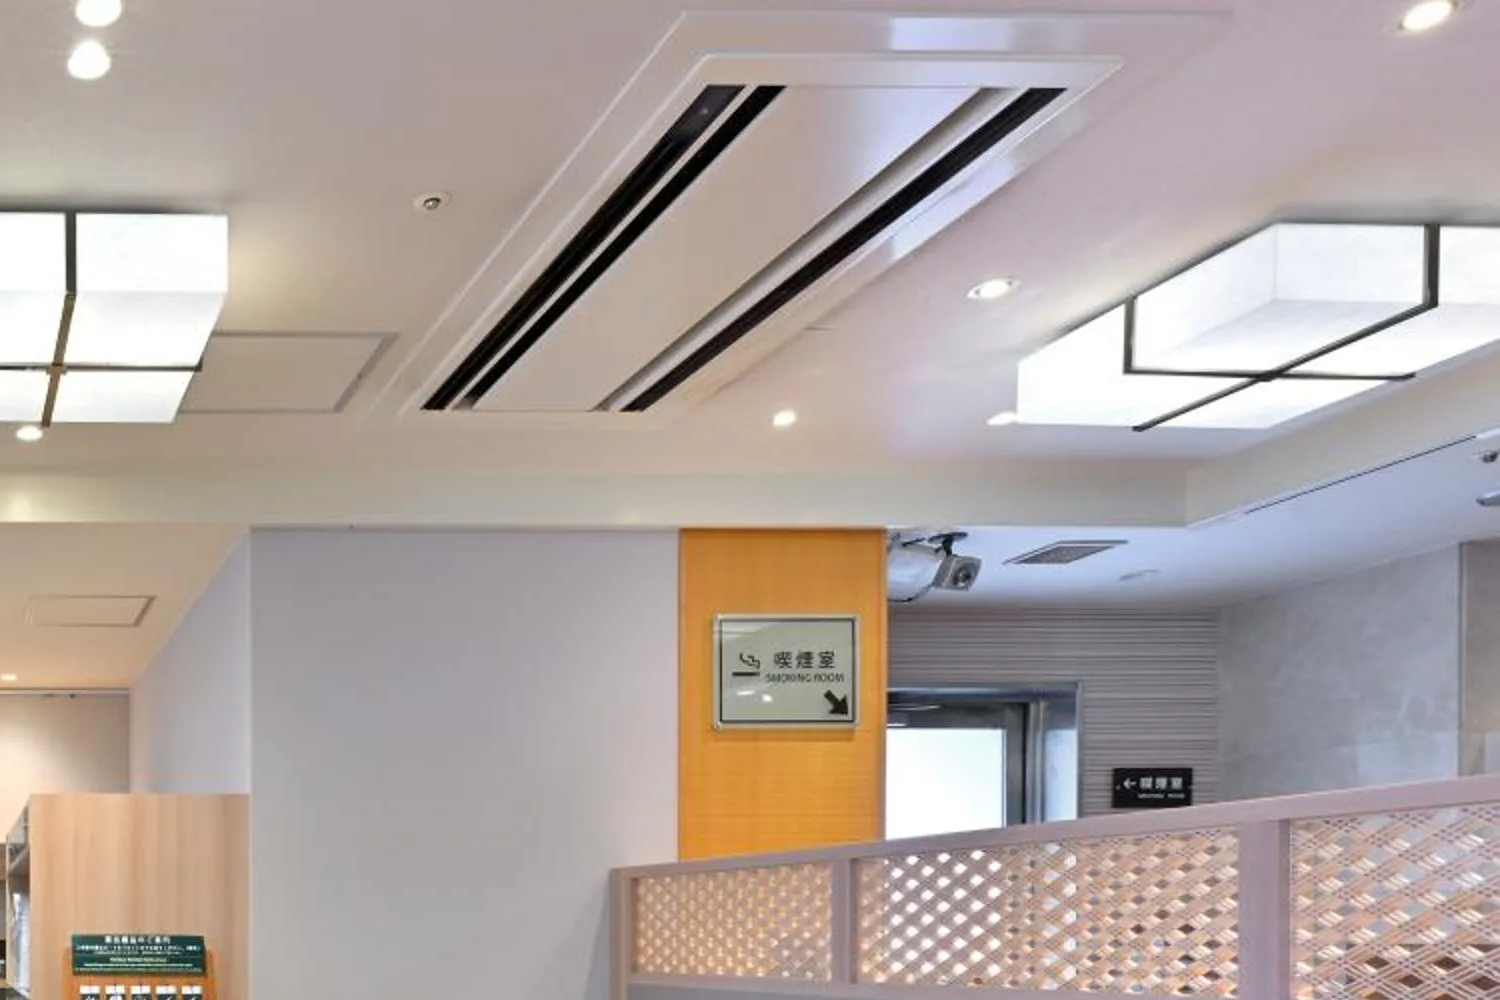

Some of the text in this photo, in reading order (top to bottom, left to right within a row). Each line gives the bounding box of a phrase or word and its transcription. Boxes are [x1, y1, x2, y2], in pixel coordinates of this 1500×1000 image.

[773, 651, 835, 669] 喫煙室
[813, 673, 845, 683] ROOM
